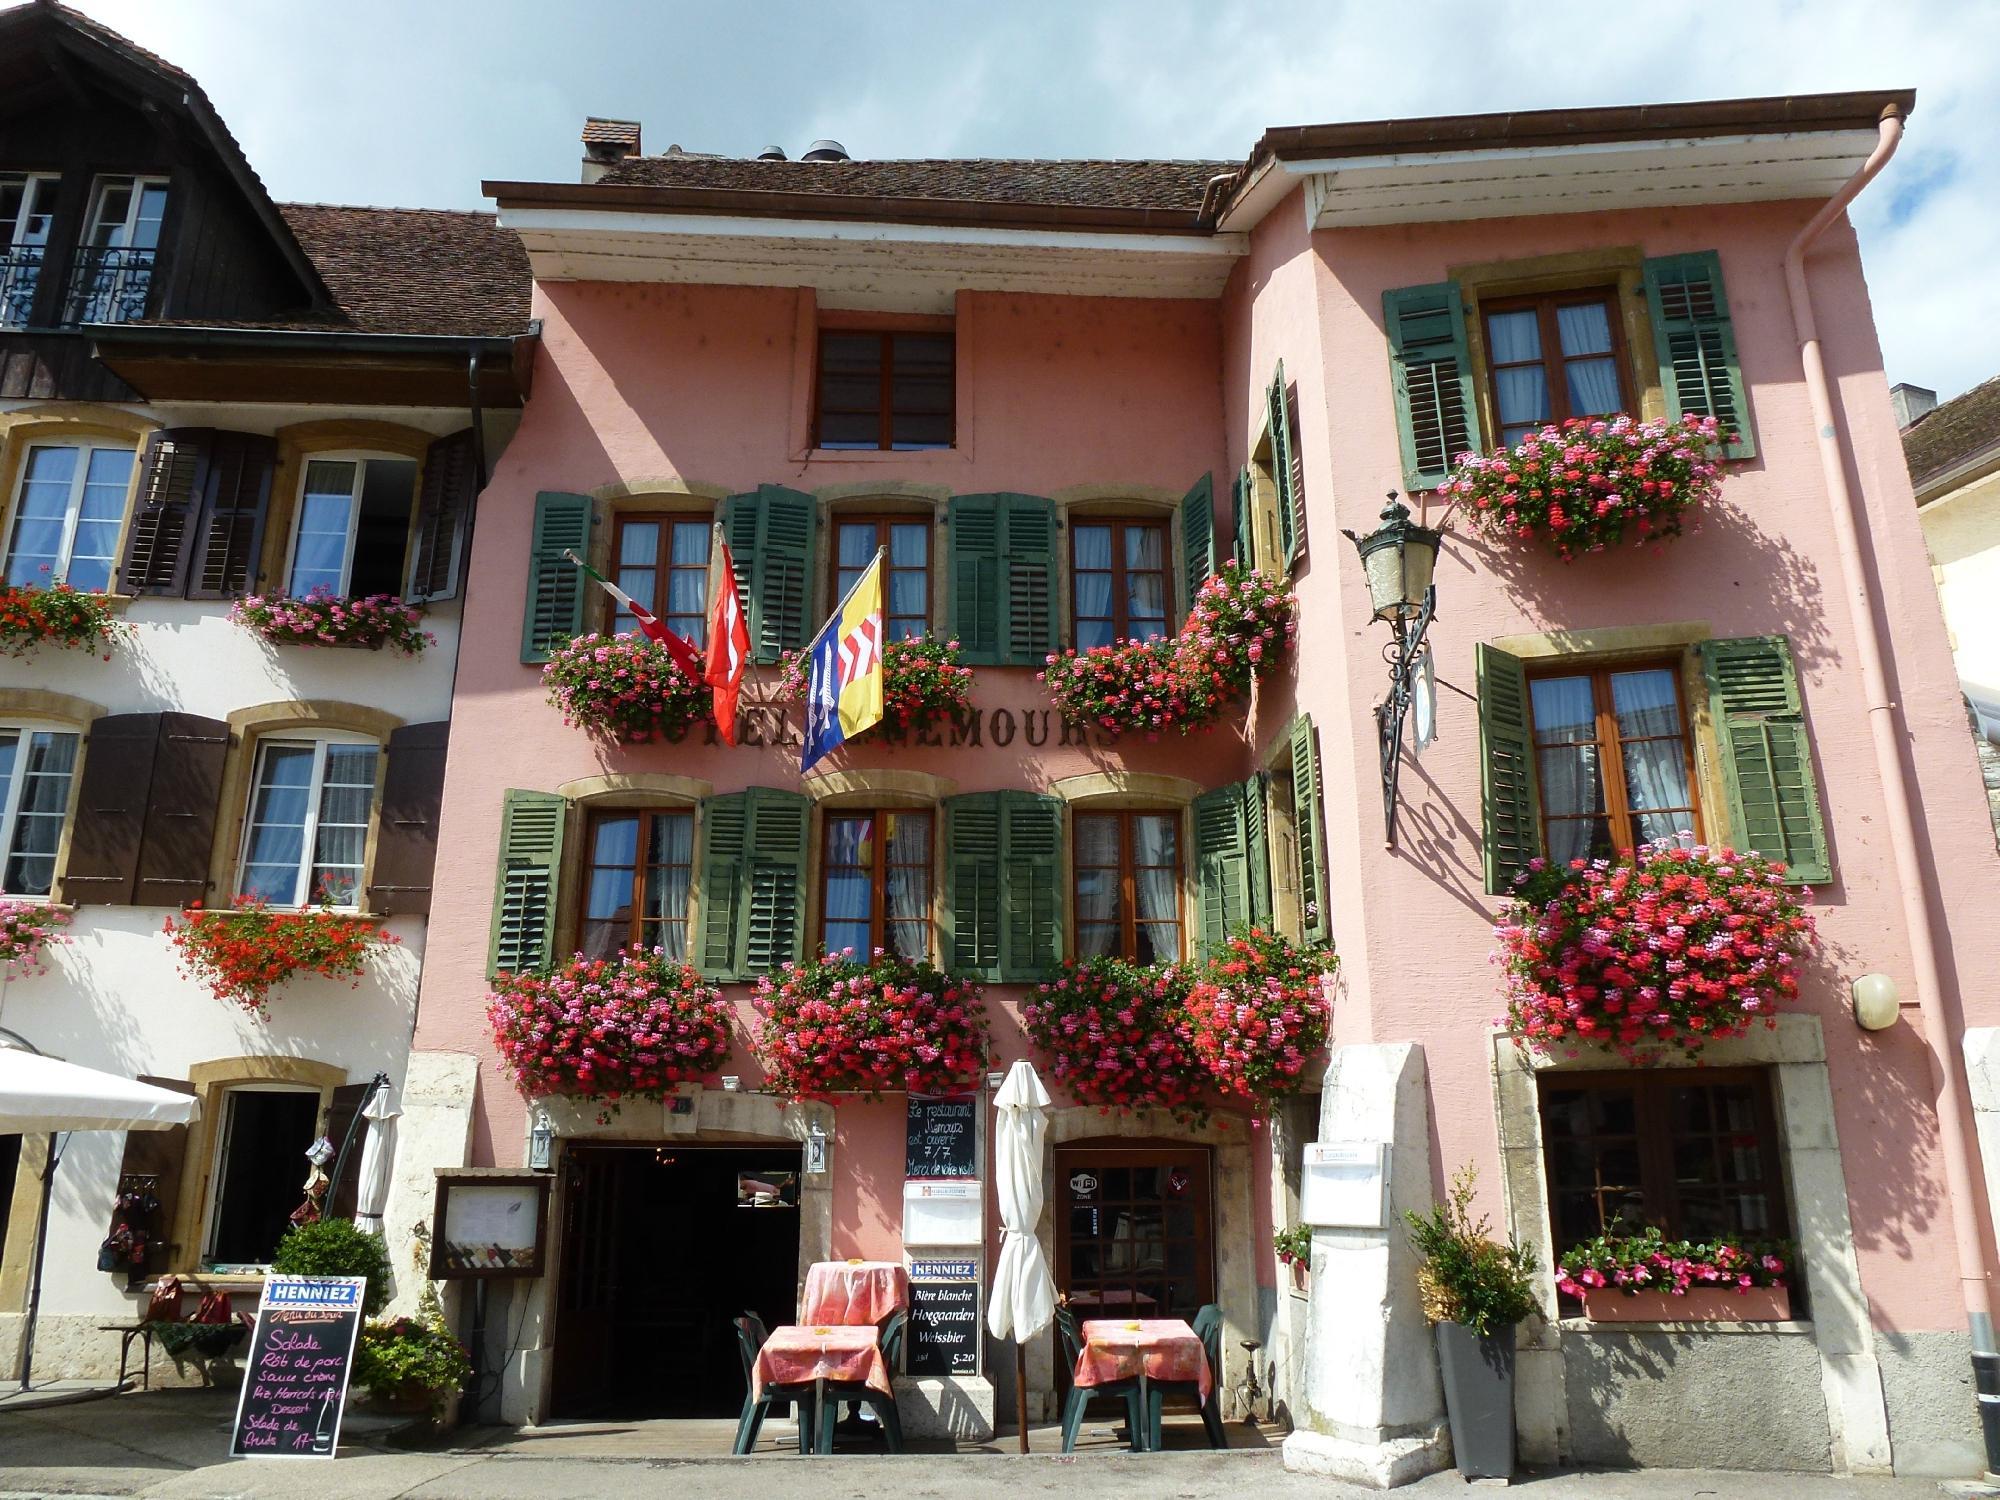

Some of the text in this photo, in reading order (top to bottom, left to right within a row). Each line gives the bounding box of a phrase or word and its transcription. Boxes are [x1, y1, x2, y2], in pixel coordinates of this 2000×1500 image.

[908, 1101, 972, 1118] Le restaurant
[908, 1131, 956, 1145] est ouvert
[906, 1158, 929, 1176] Merci
[930, 1159, 940, 1176] de
[941, 1157, 958, 1175] votre
[915, 1264, 971, 1275] HENNIEZ
[274, 1285, 351, 1300] HENNIEZ
[914, 1289, 973, 1301] Bière blanche
[912, 1307, 975, 1327] Hoegaarden
[264, 1329, 322, 1351] Salade
[919, 1330, 966, 1343] Weissbier
[294, 1355, 311, 1368] de
[951, 1353, 975, 1365] 5.20
[244, 1412, 300, 1431] Salade de
